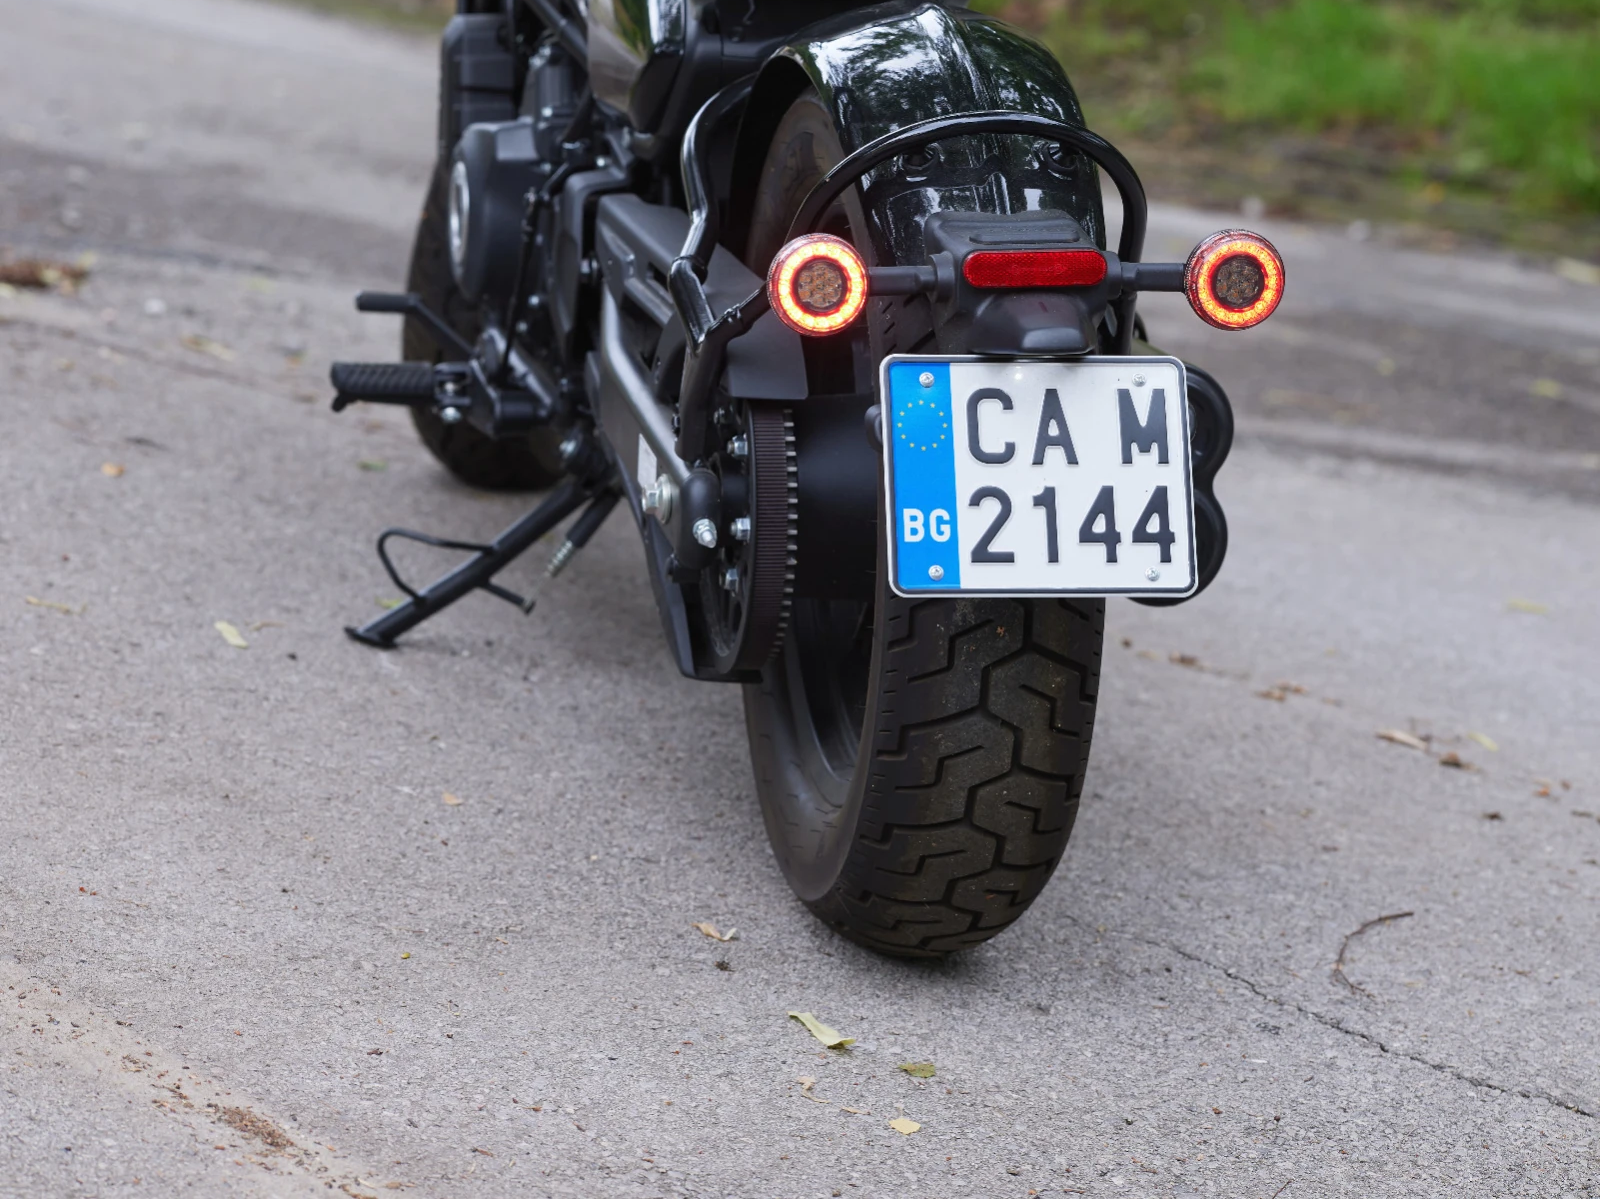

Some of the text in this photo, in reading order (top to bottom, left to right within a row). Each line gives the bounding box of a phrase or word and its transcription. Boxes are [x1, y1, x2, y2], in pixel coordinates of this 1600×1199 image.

[966, 387, 1170, 465] CA M
[902, 508, 951, 543] BG
[968, 485, 1176, 564] 2144
